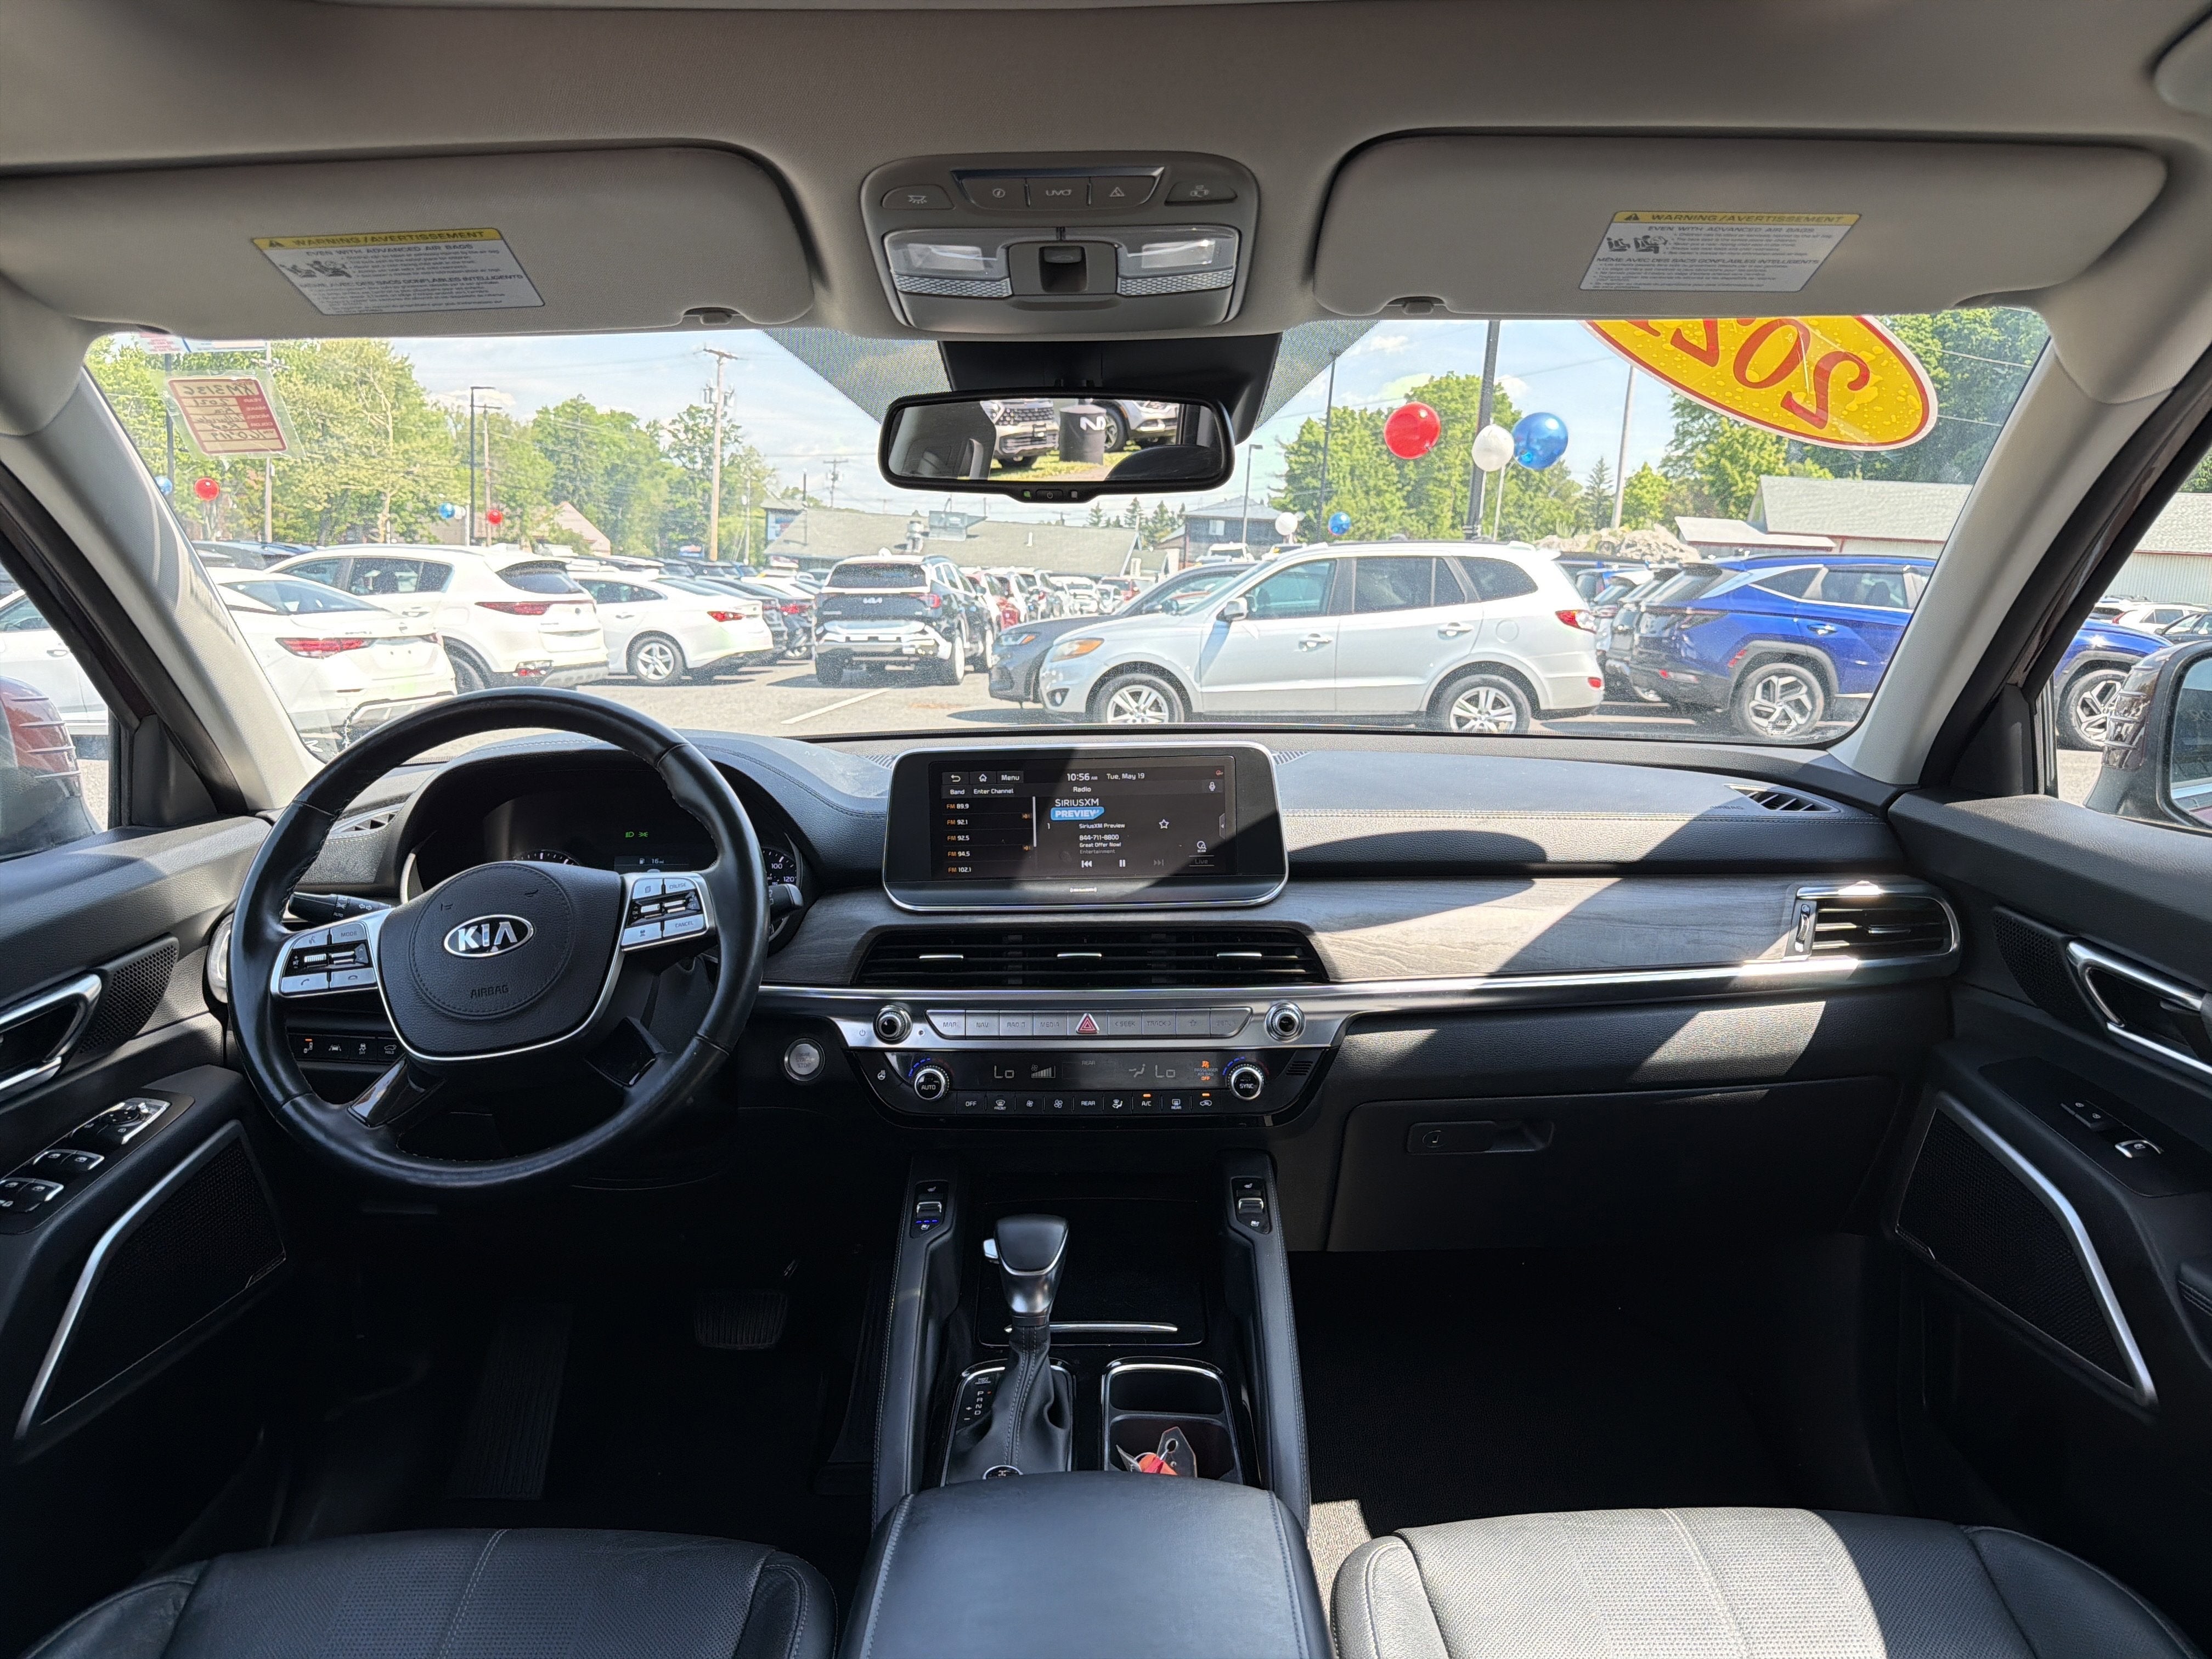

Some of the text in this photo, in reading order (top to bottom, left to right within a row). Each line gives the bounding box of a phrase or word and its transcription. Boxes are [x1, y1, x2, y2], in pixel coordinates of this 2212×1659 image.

[458, 921, 518, 951] KIA
[470, 985, 509, 998] AIRBAG
[994, 1065, 1014, 1079] Lo
[1155, 1065, 1176, 1078] Lo
